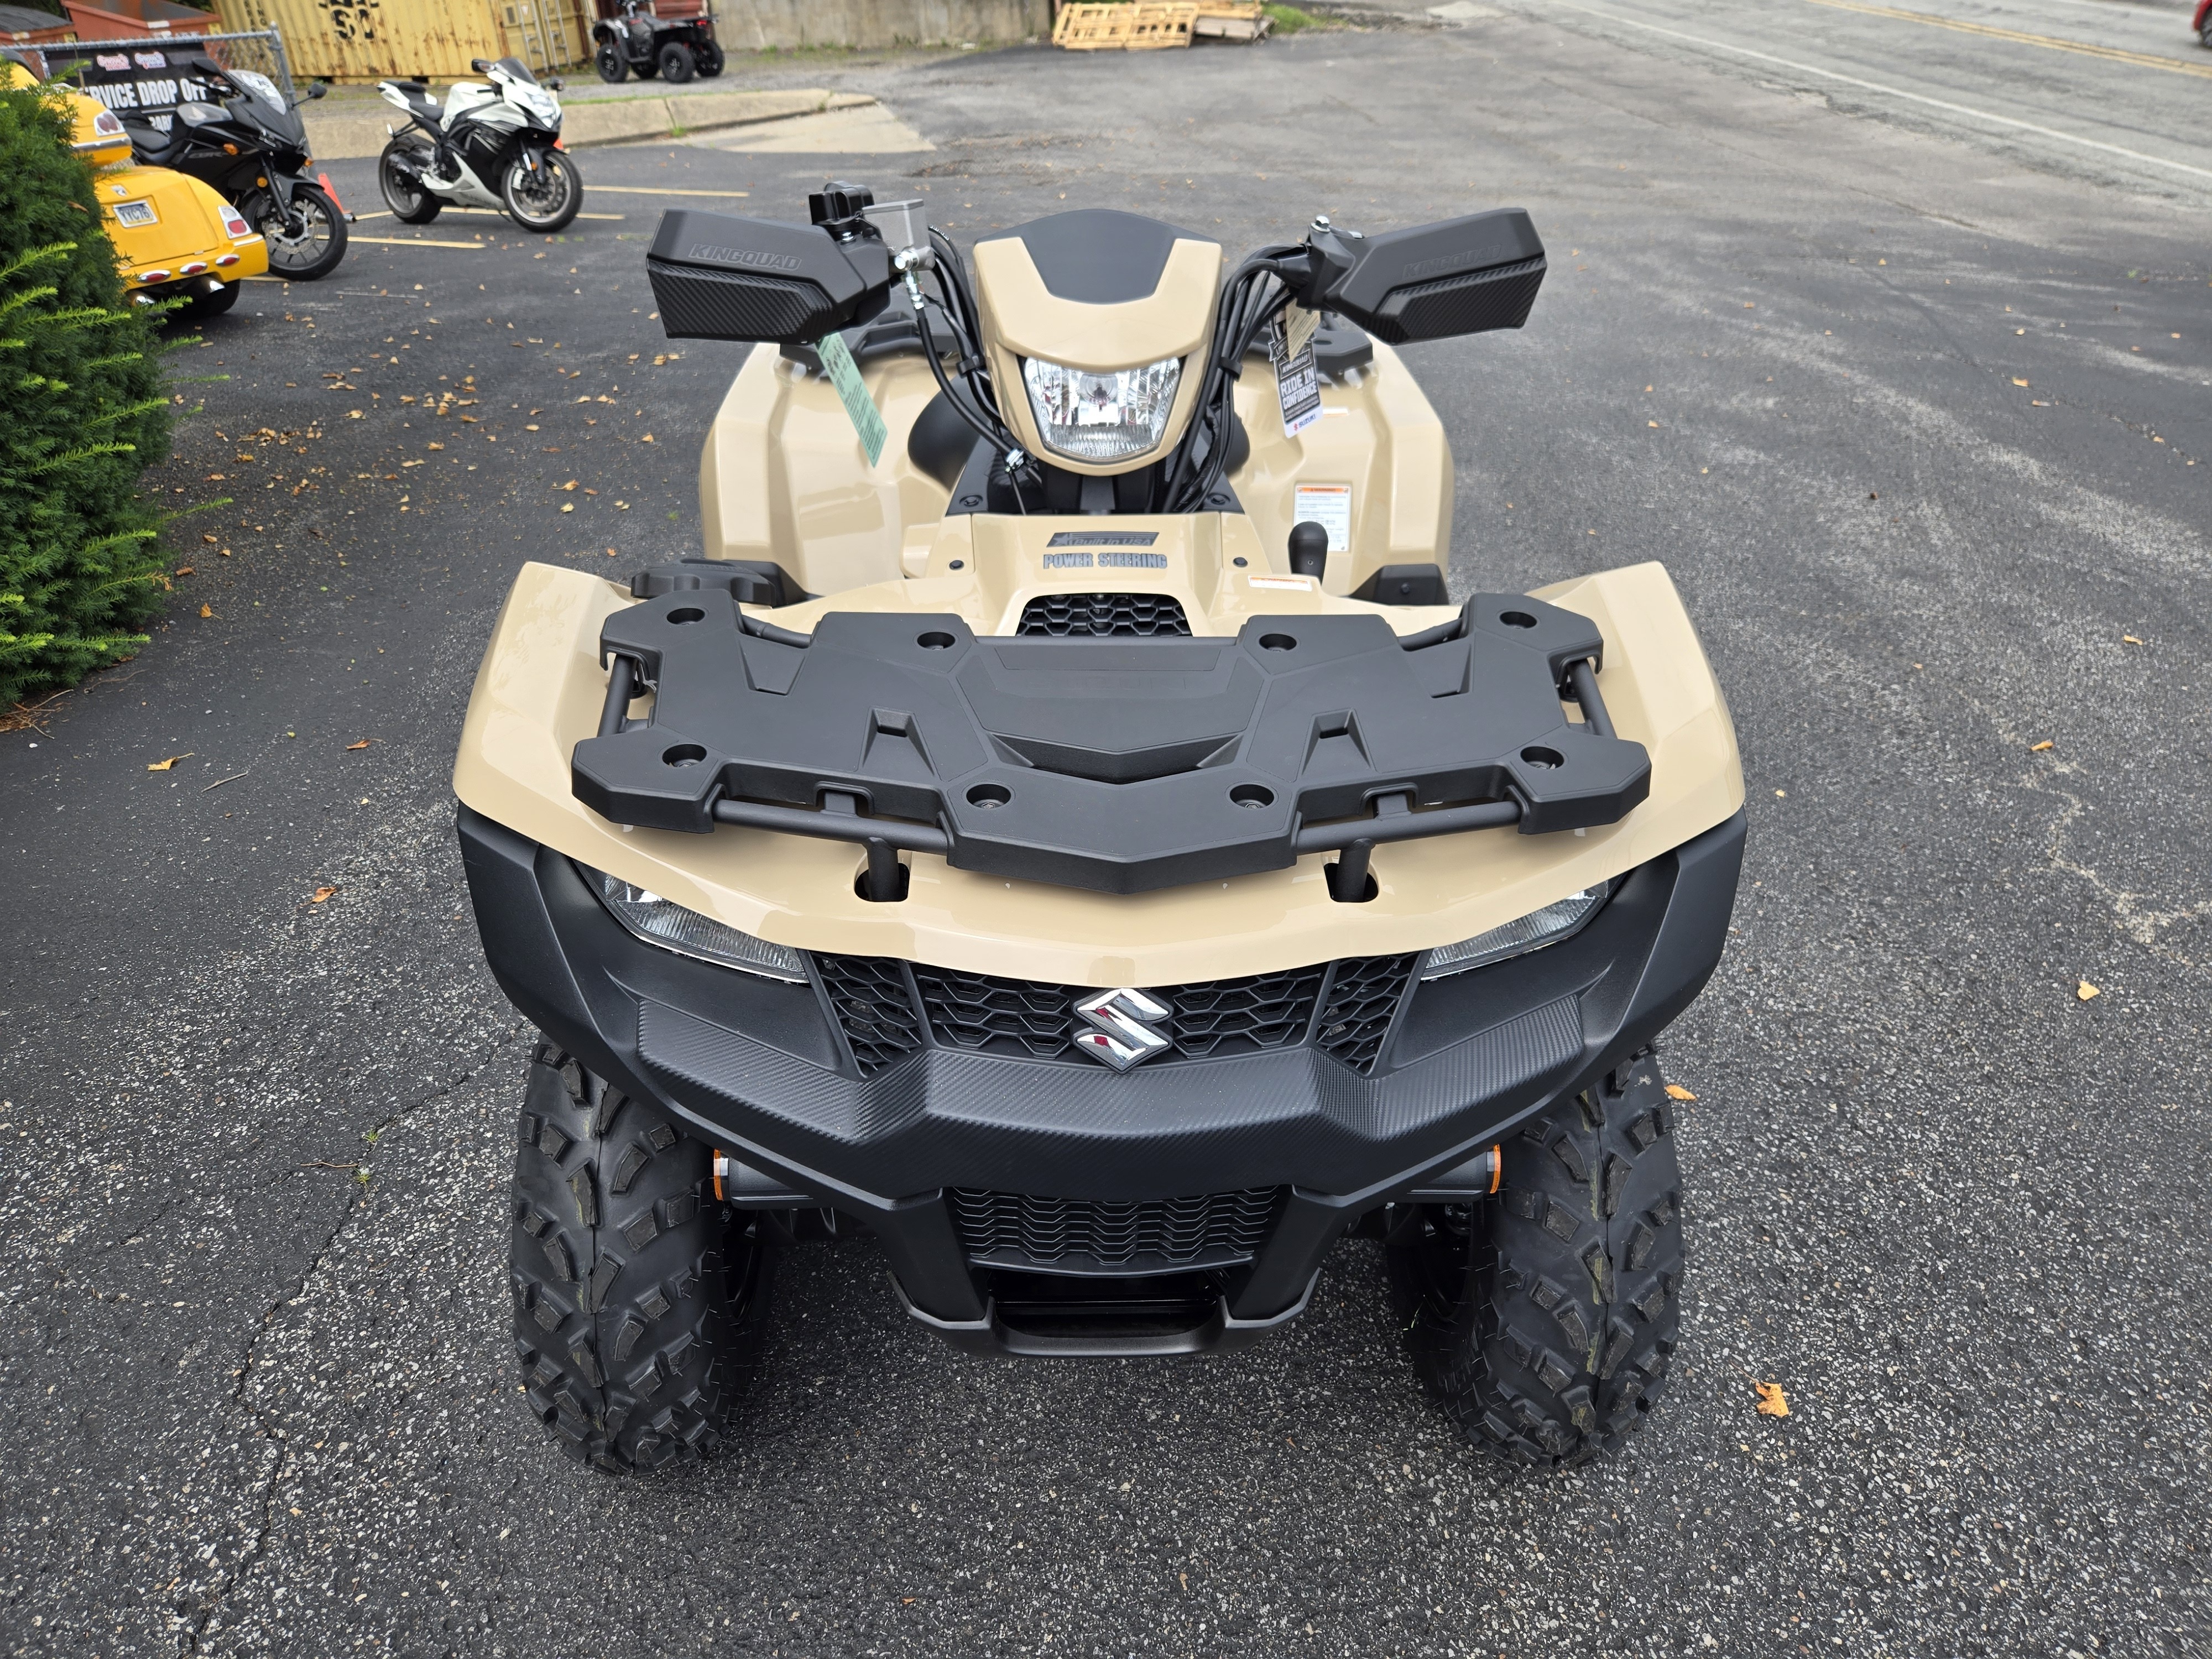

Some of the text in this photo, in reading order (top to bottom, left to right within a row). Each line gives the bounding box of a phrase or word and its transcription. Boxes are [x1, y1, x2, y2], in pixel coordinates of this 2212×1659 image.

[85, 83, 138, 109] RVICE
[137, 80, 178, 106] DROP
[688, 243, 802, 271] KINGQUAD
[1404, 244, 1501, 276] KINGQUAD
[1280, 367, 1315, 397] RIDE IN
[1282, 380, 1317, 410] CONFIDENCE
[1298, 413, 1316, 427] SUZUKI
[1044, 552, 1167, 569] POWER STEERING
